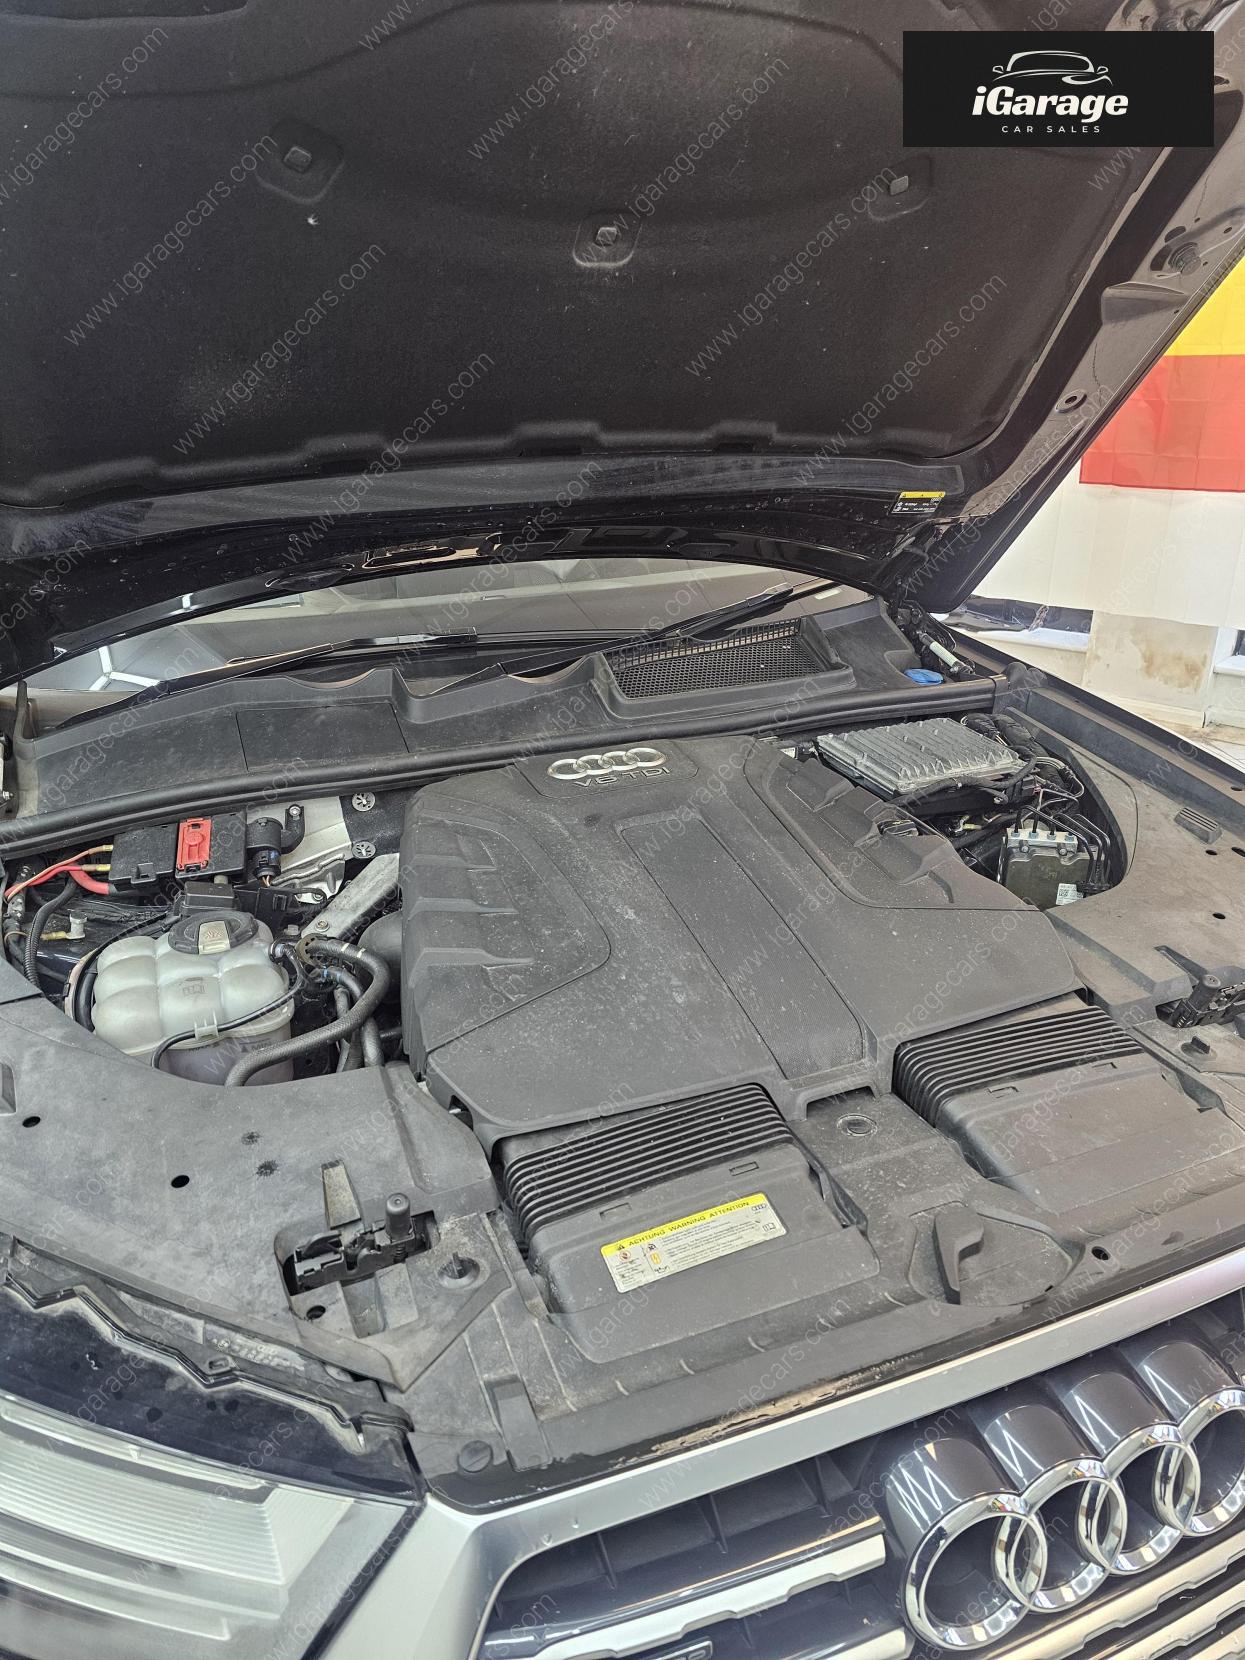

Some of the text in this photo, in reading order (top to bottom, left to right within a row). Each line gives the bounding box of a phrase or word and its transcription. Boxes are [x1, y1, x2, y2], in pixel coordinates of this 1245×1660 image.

[574, 766, 670, 787] V6 TDI
[629, 1202, 749, 1245] ACHTUNG WARNING ATTENTION
